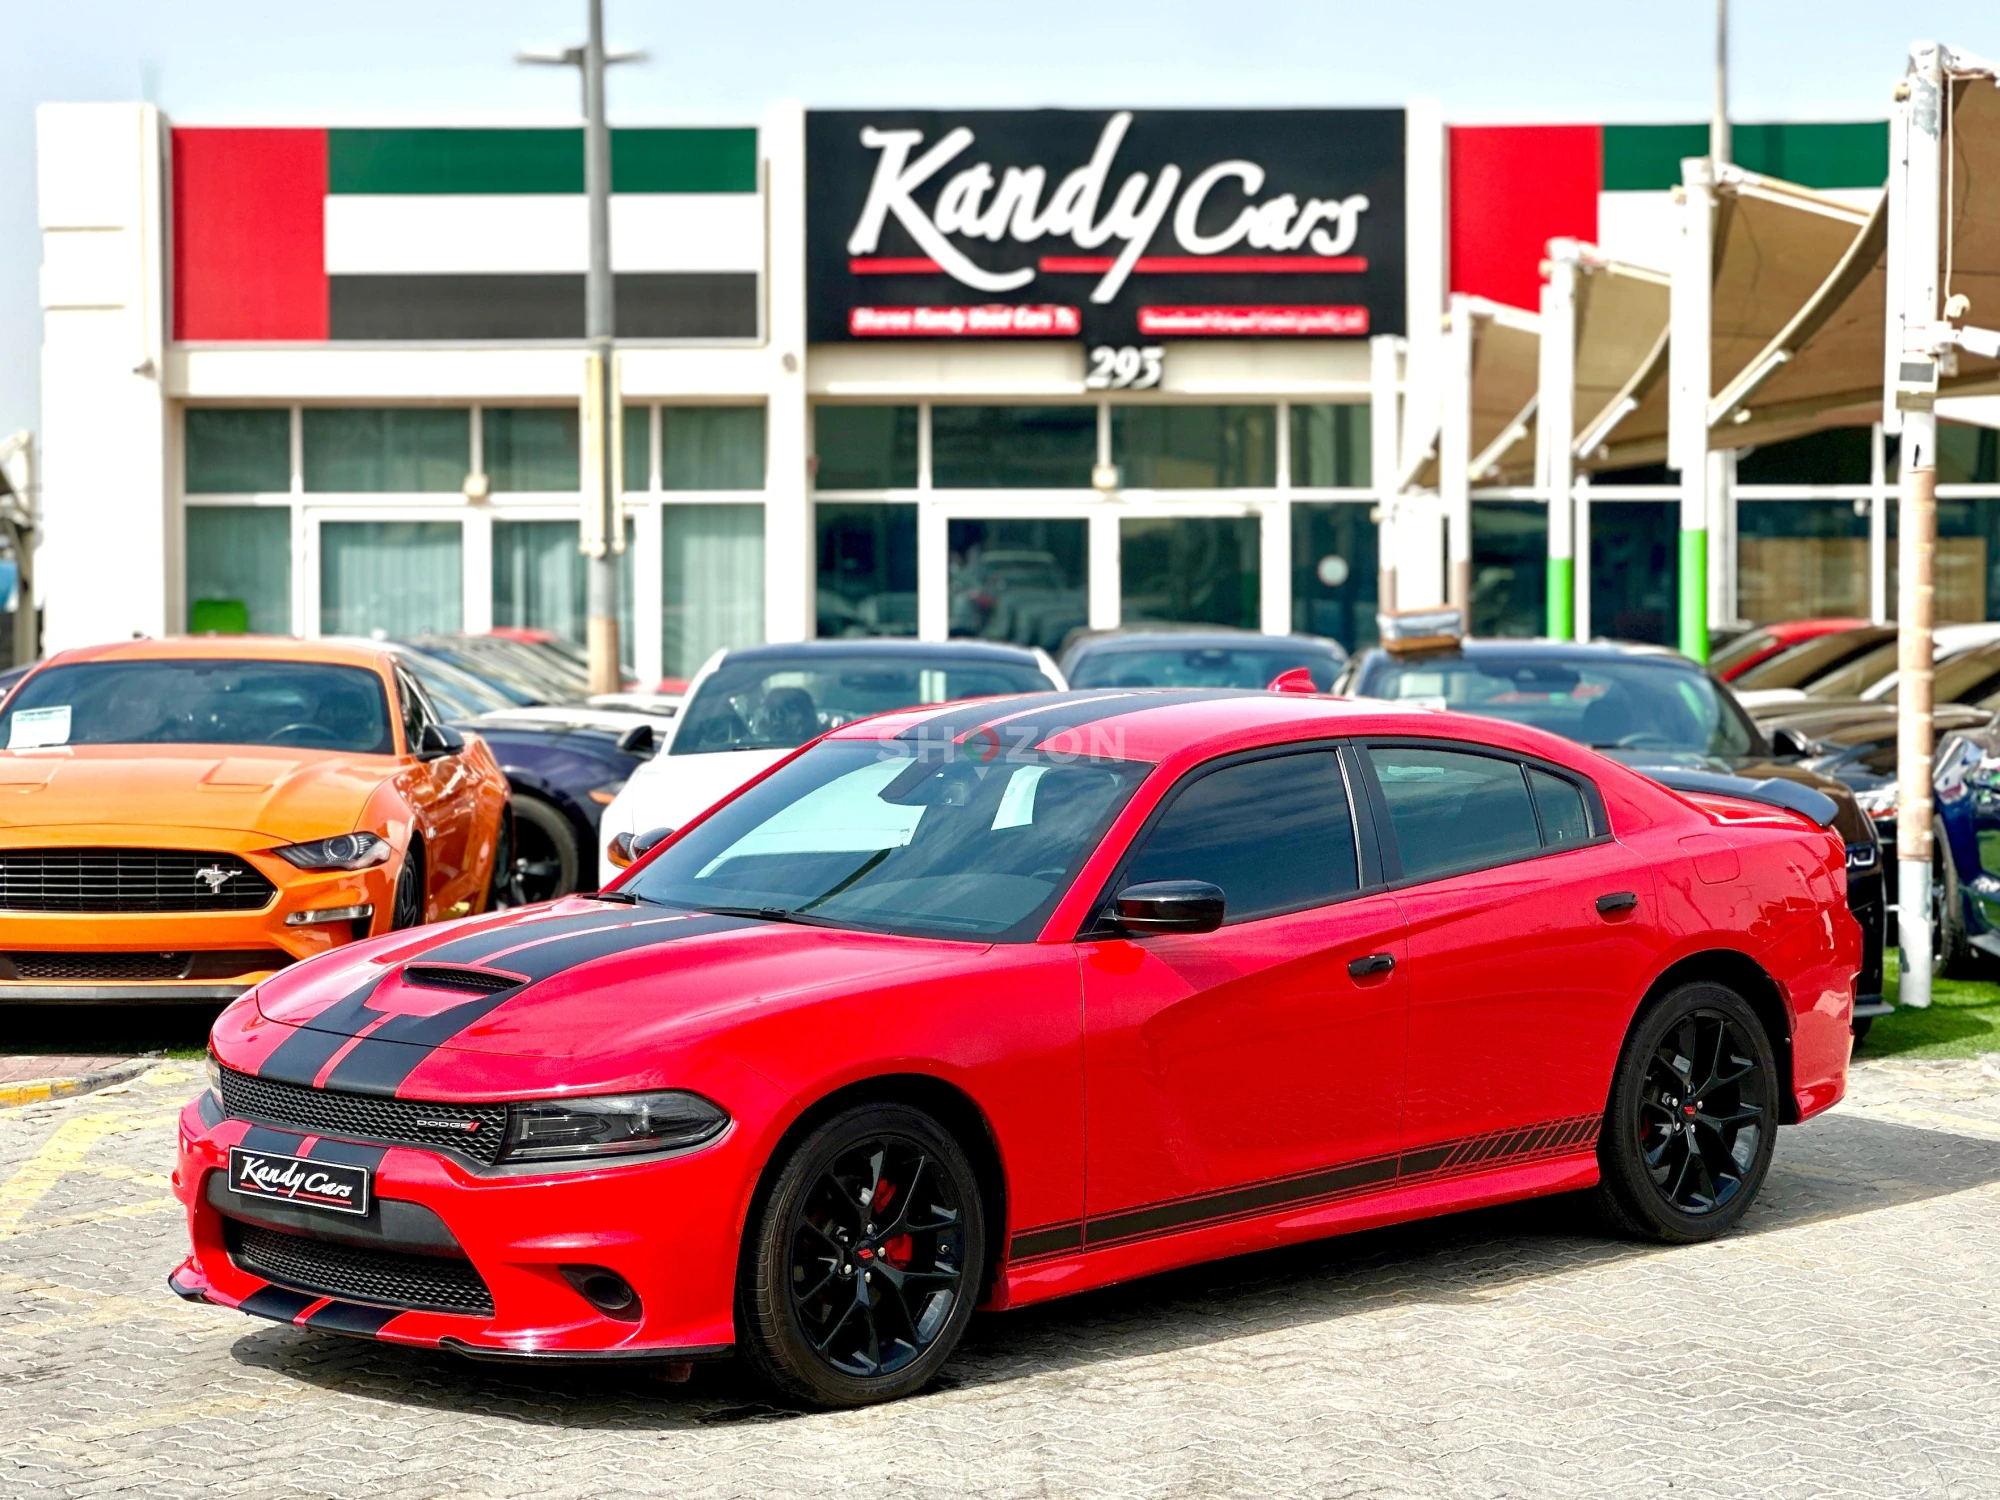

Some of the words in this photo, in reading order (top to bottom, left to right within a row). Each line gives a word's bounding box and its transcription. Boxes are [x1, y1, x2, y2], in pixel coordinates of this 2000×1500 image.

[848, 111, 1181, 303] Kandy
[1174, 160, 1370, 256] Cars
[1086, 345, 1165, 389] 295
[416, 1119, 471, 1130] DODGE
[240, 1155, 305, 1198] Kandy
[304, 1173, 353, 1198] Cars
